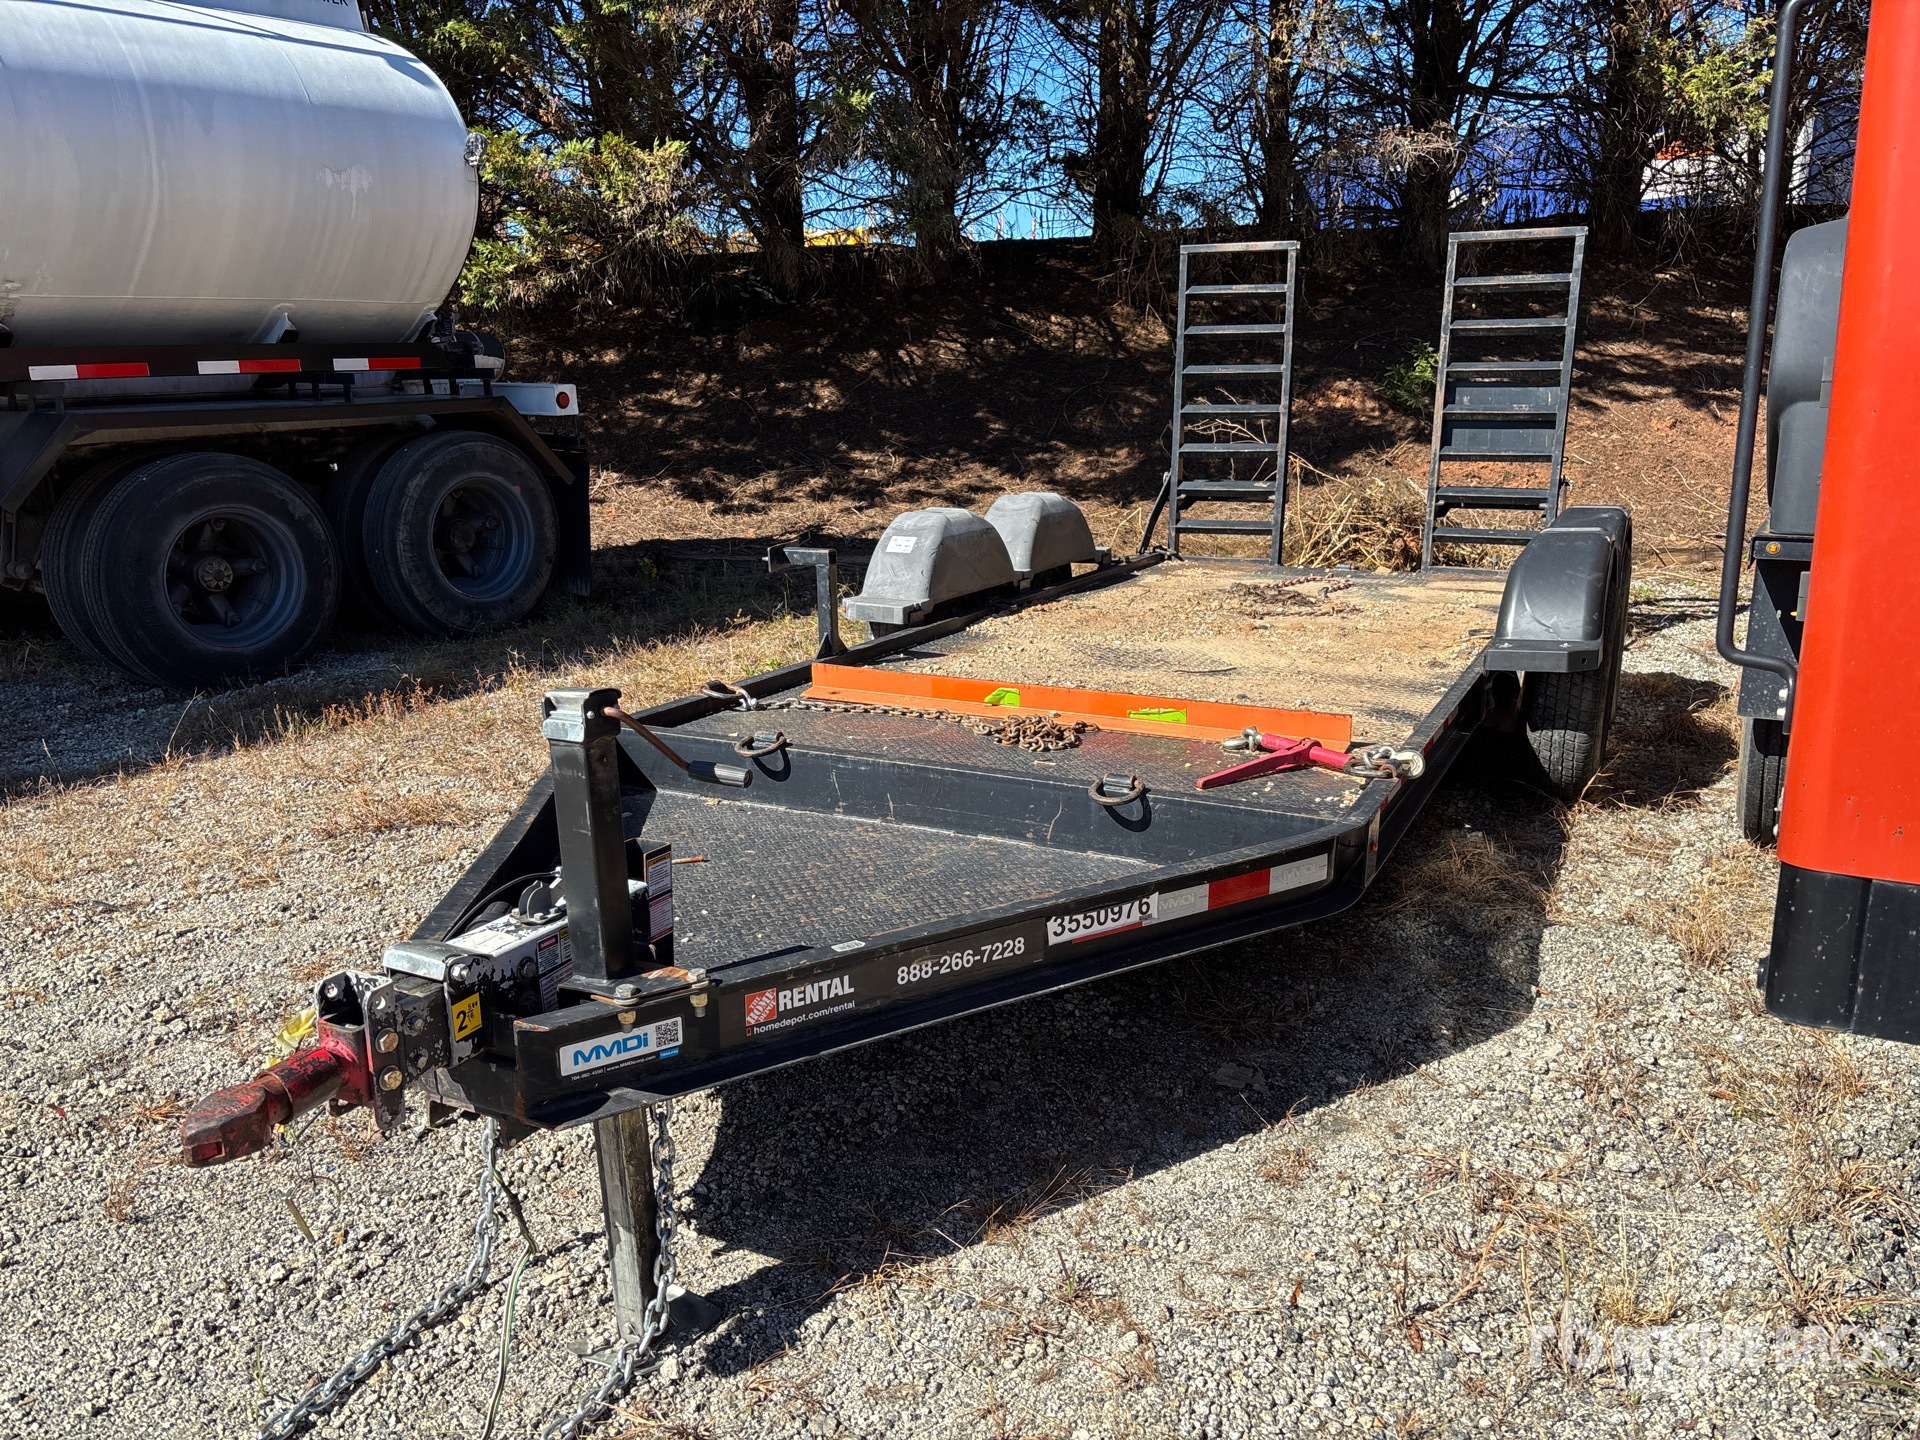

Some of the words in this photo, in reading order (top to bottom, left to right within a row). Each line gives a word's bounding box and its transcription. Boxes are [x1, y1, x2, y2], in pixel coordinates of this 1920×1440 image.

[1052, 898, 1151, 937] 3550976
[897, 937, 1025, 985] 888-266-7228
[746, 990, 776, 1024] HOME
[749, 995, 762, 1009] THE
[778, 975, 855, 1012] RENTAL
[456, 1010, 468, 1033] 2
[754, 1000, 855, 1035] homedepot.com/rental
[758, 1000, 776, 1022] DEPOT
[573, 1032, 648, 1066] MMDi
